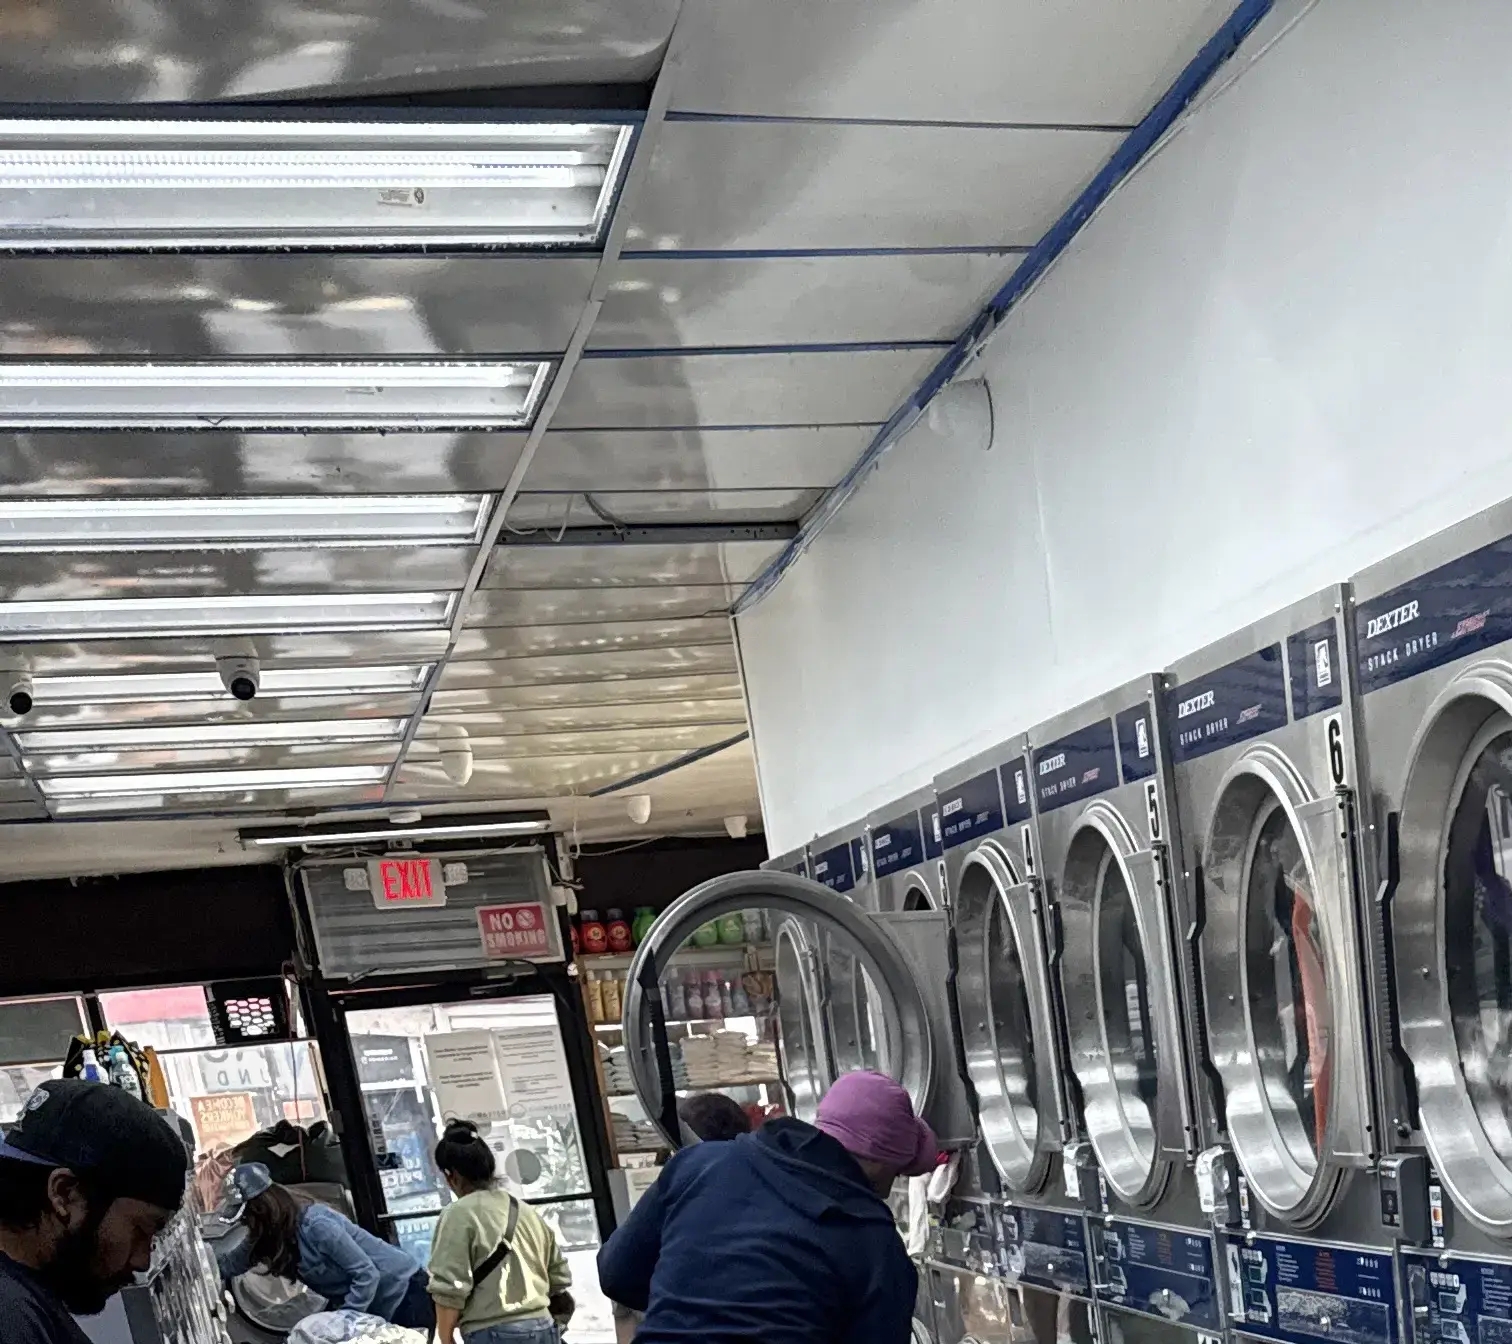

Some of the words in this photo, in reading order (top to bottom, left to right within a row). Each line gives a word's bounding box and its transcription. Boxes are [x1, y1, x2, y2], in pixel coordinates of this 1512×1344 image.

[1366, 599, 1420, 639] DEXTER
[1367, 647, 1399, 672] STACK
[1178, 690, 1215, 719] DEXTER
[1328, 718, 1343, 782] 6
[1147, 784, 1160, 839] 5
[380, 859, 433, 901] EXIT
[486, 928, 545, 948] SMOKING
[490, 912, 513, 931] NO
